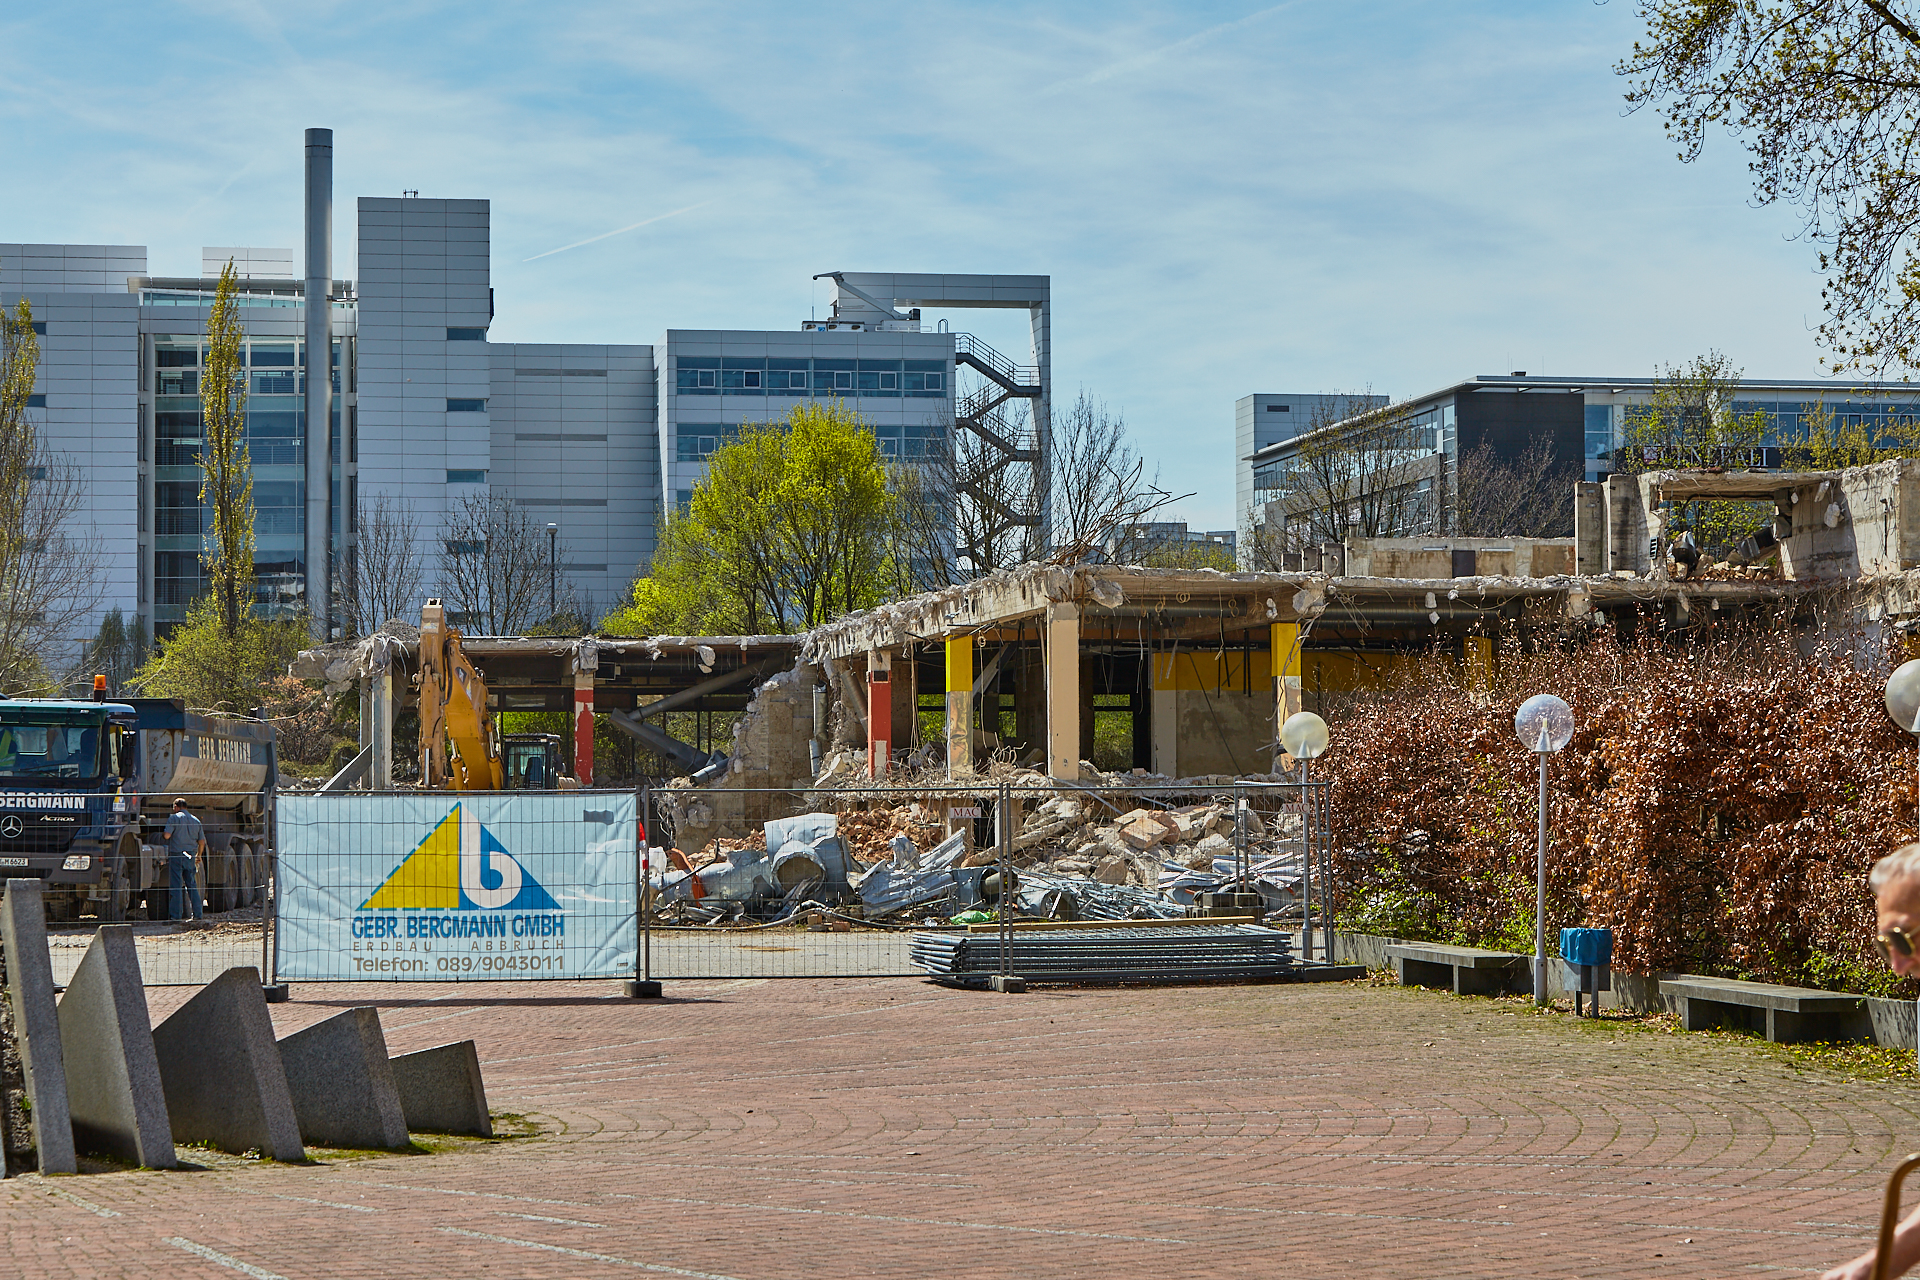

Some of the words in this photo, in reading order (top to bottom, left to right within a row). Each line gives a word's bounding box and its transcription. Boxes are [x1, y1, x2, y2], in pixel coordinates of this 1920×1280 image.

[218, 739, 251, 764] BERGMANN
[0, 791, 85, 809] BERGMANN
[1286, 804, 1308, 812] MAC
[953, 808, 979, 817] MAC
[352, 915, 403, 939] GEBR.
[407, 914, 506, 938] BERGMANN
[512, 914, 564, 938] GMBH
[353, 941, 432, 952] ERDBAU
[471, 939, 564, 951] ABBRUCH
[353, 957, 429, 972] Telefon:
[437, 955, 564, 973] 089/9043011
